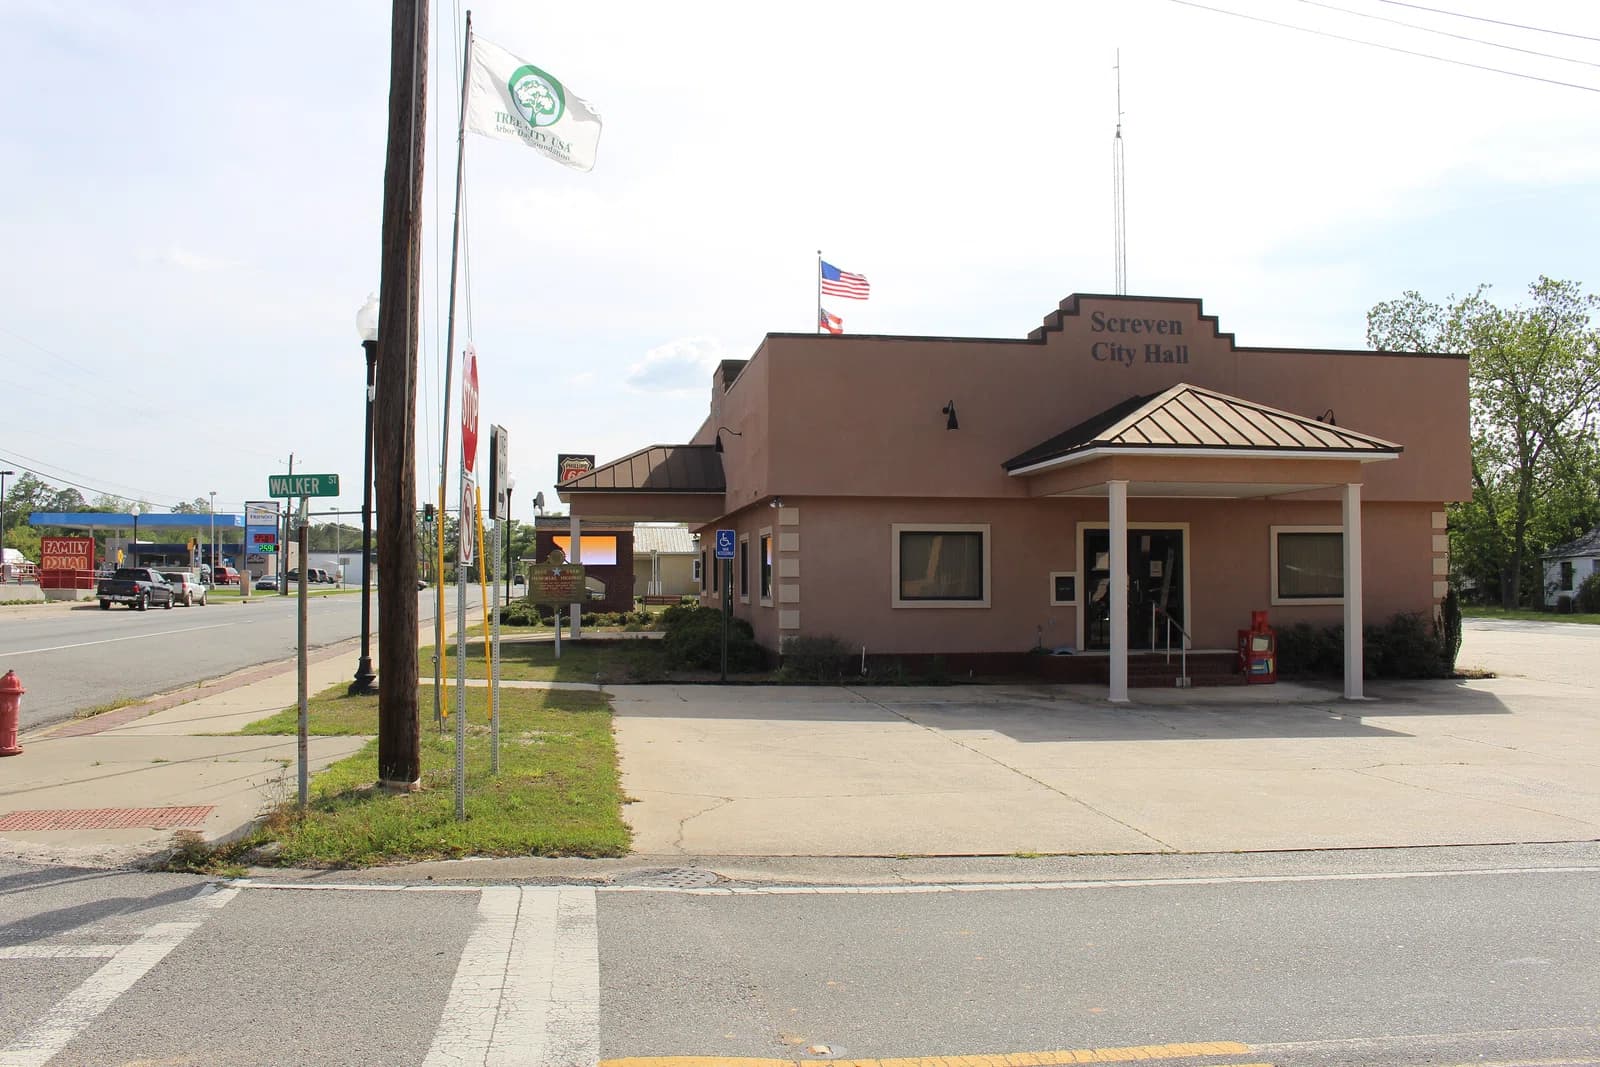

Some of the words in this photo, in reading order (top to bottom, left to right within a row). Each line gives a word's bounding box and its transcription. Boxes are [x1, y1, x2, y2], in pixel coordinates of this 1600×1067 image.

[495, 124, 515, 135] Arbor
[495, 111, 523, 129] TREE
[552, 137, 573, 152] USA
[1091, 311, 1183, 335] Screven
[1091, 342, 1136, 368] City
[1144, 343, 1189, 364] Hall
[462, 379, 478, 434] STOP
[270, 478, 319, 495] WALKER
[328, 475, 337, 484] ST
[43, 541, 89, 554] FAMILY
